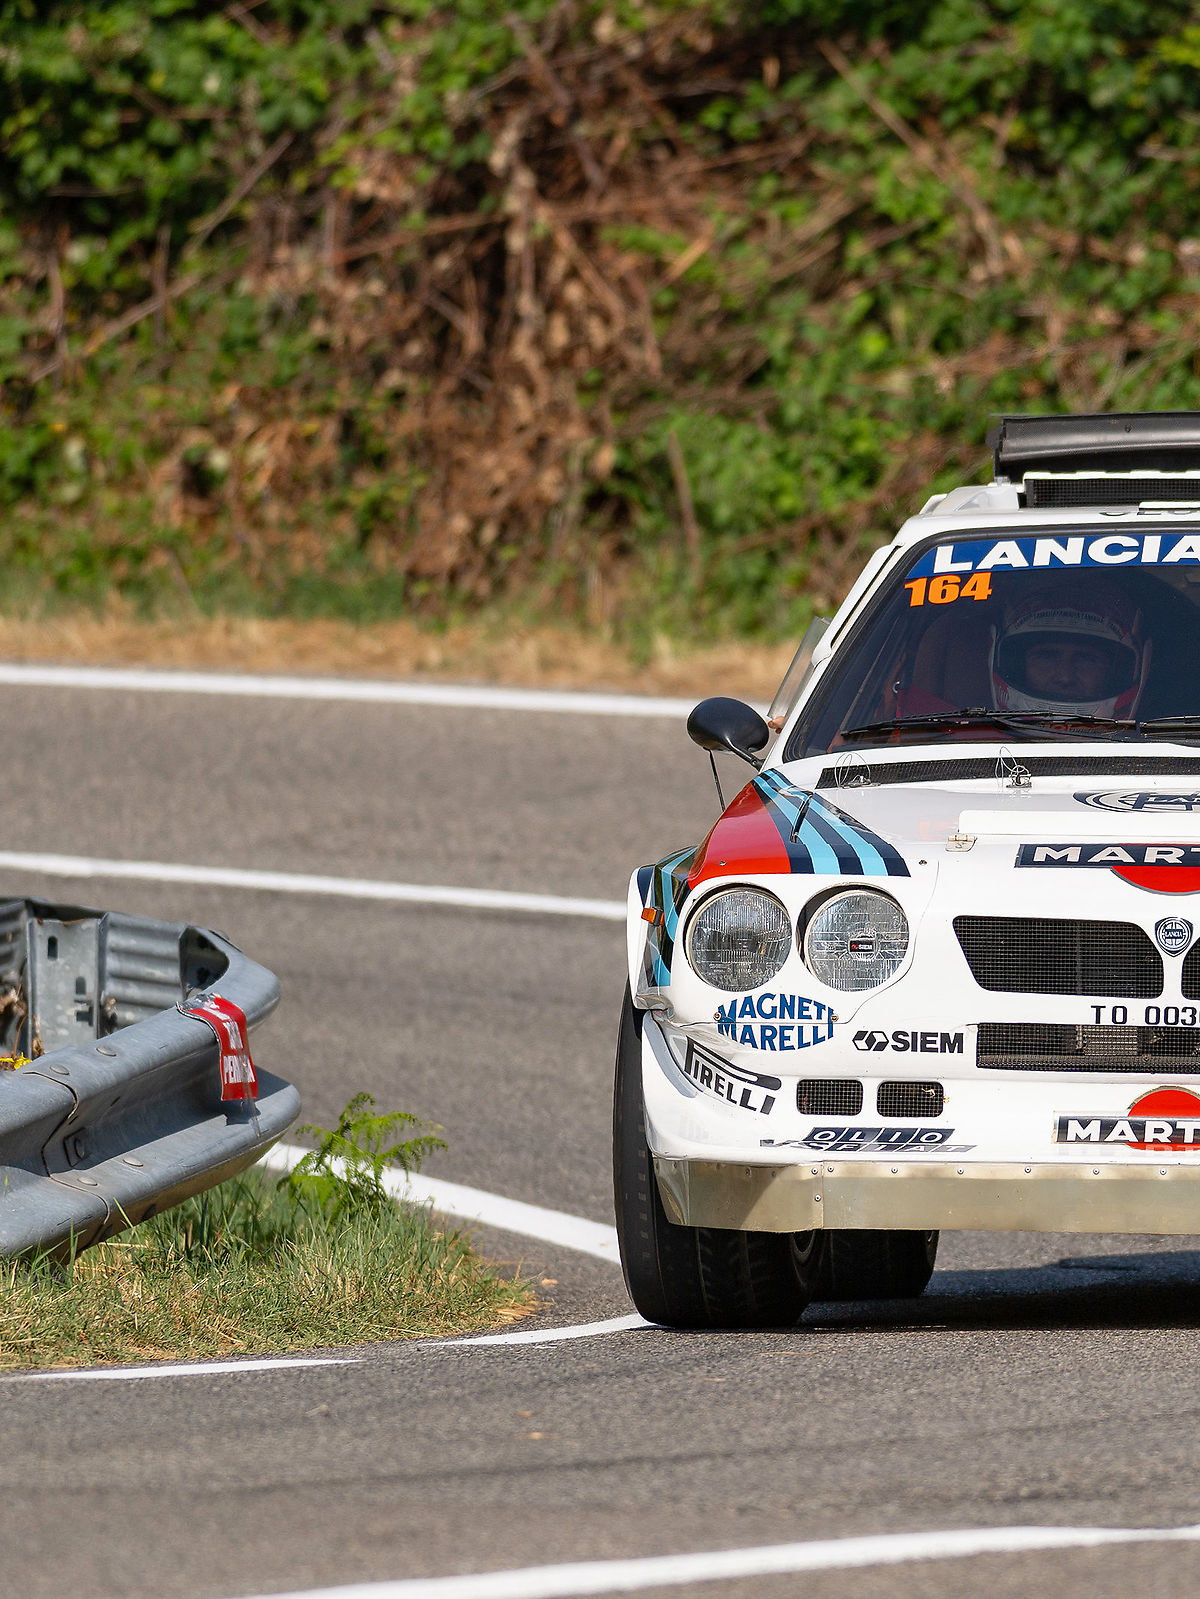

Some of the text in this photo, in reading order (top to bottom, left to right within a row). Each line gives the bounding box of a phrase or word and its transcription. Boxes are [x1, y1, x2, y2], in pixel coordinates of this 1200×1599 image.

[904, 572, 993, 607] 164
[717, 993, 835, 1021] MAGNETI
[717, 1024, 834, 1051] MARELLI
[891, 1030, 964, 1053] SIEM
[684, 1035, 782, 1115] PIRELLI
[813, 1130, 943, 1143] OLIO
